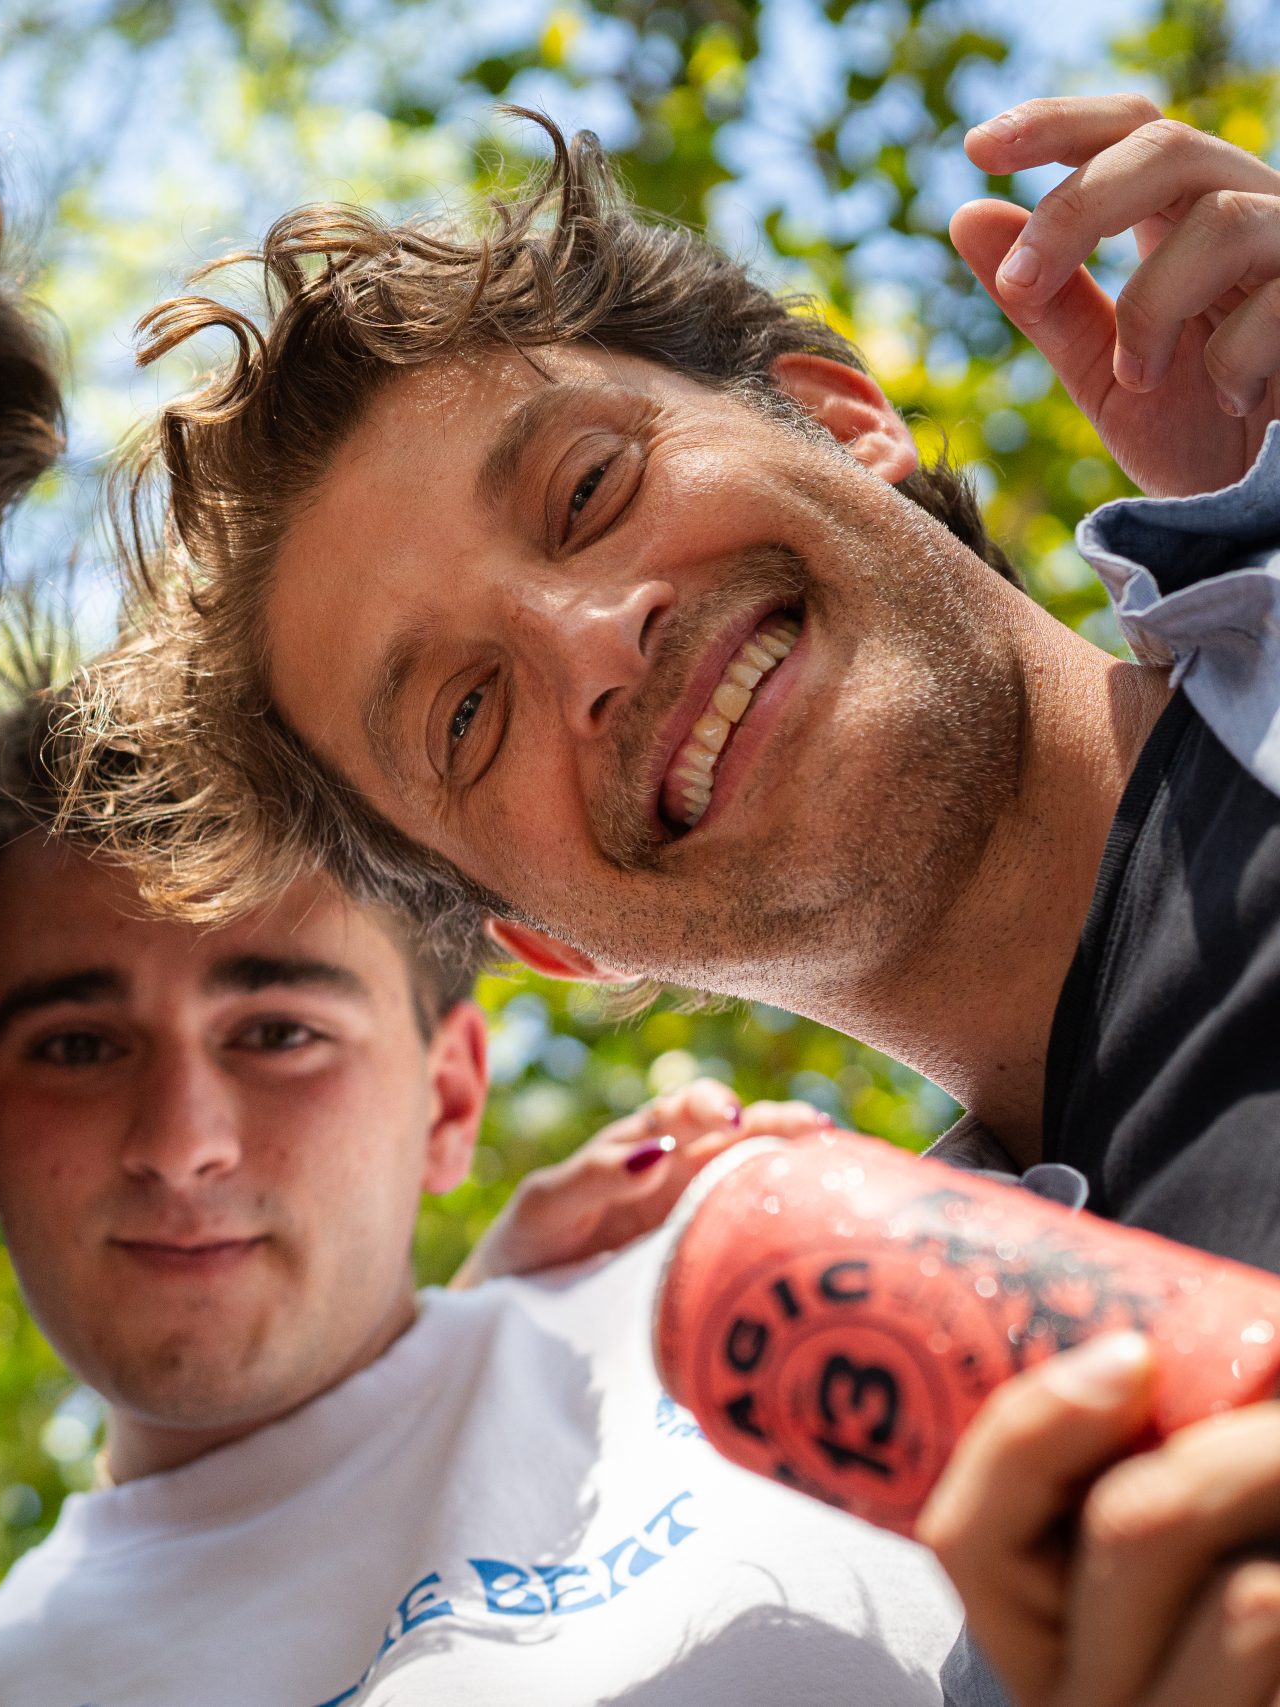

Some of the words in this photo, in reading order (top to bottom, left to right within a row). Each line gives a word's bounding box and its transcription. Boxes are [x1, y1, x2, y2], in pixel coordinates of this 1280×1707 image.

[723, 1258, 871, 1485] AGIC
[818, 1354, 902, 1482] 13
[466, 1489, 700, 1617] BEAT
